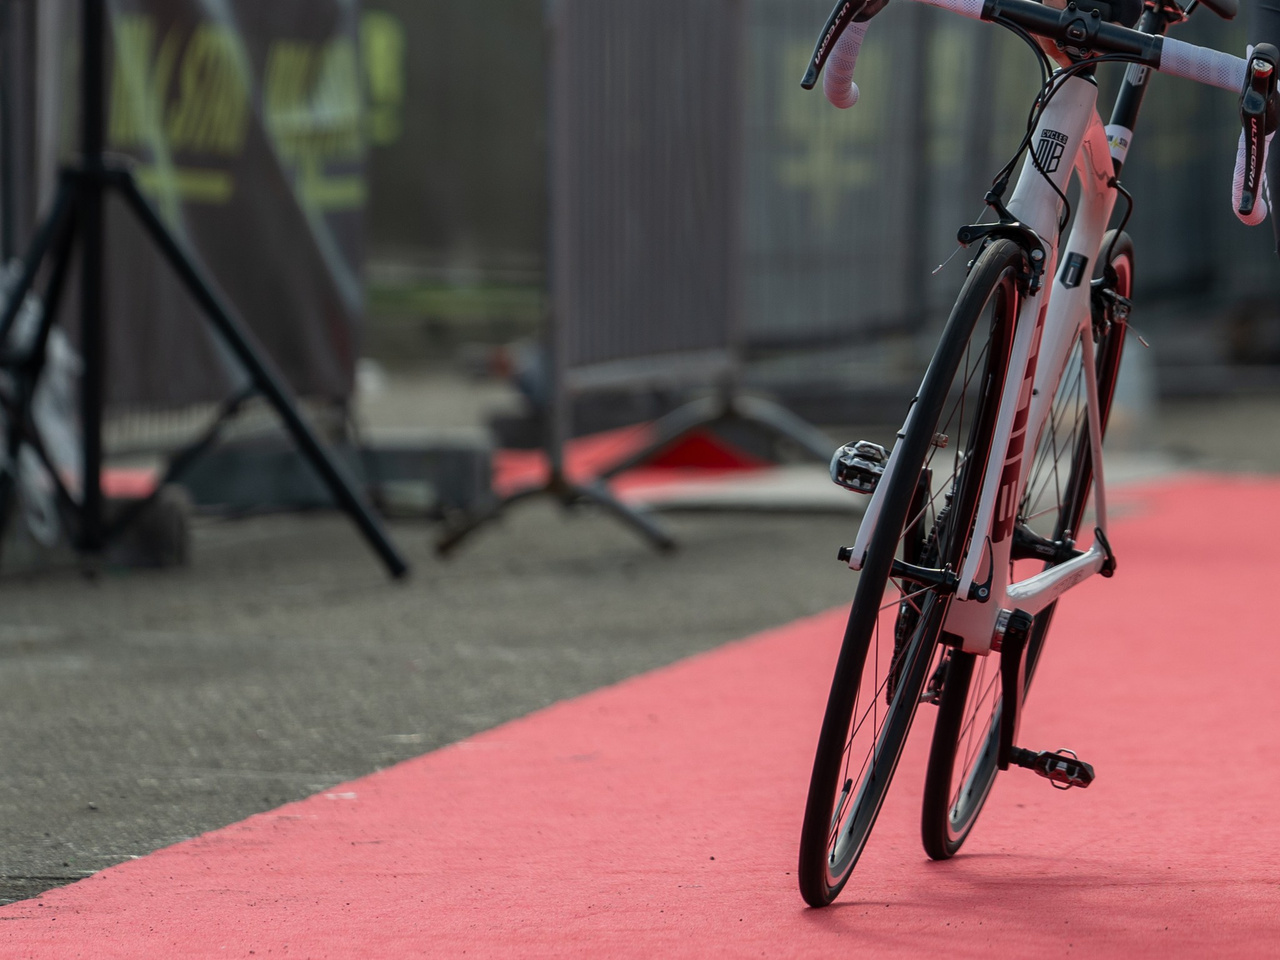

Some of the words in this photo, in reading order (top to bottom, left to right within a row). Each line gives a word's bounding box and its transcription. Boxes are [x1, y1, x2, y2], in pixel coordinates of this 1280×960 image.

[815, 2, 850, 64] ULTEGRA
[1041, 129, 1068, 145] CYCLES
[1248, 117, 1257, 189] ULTEGRA
